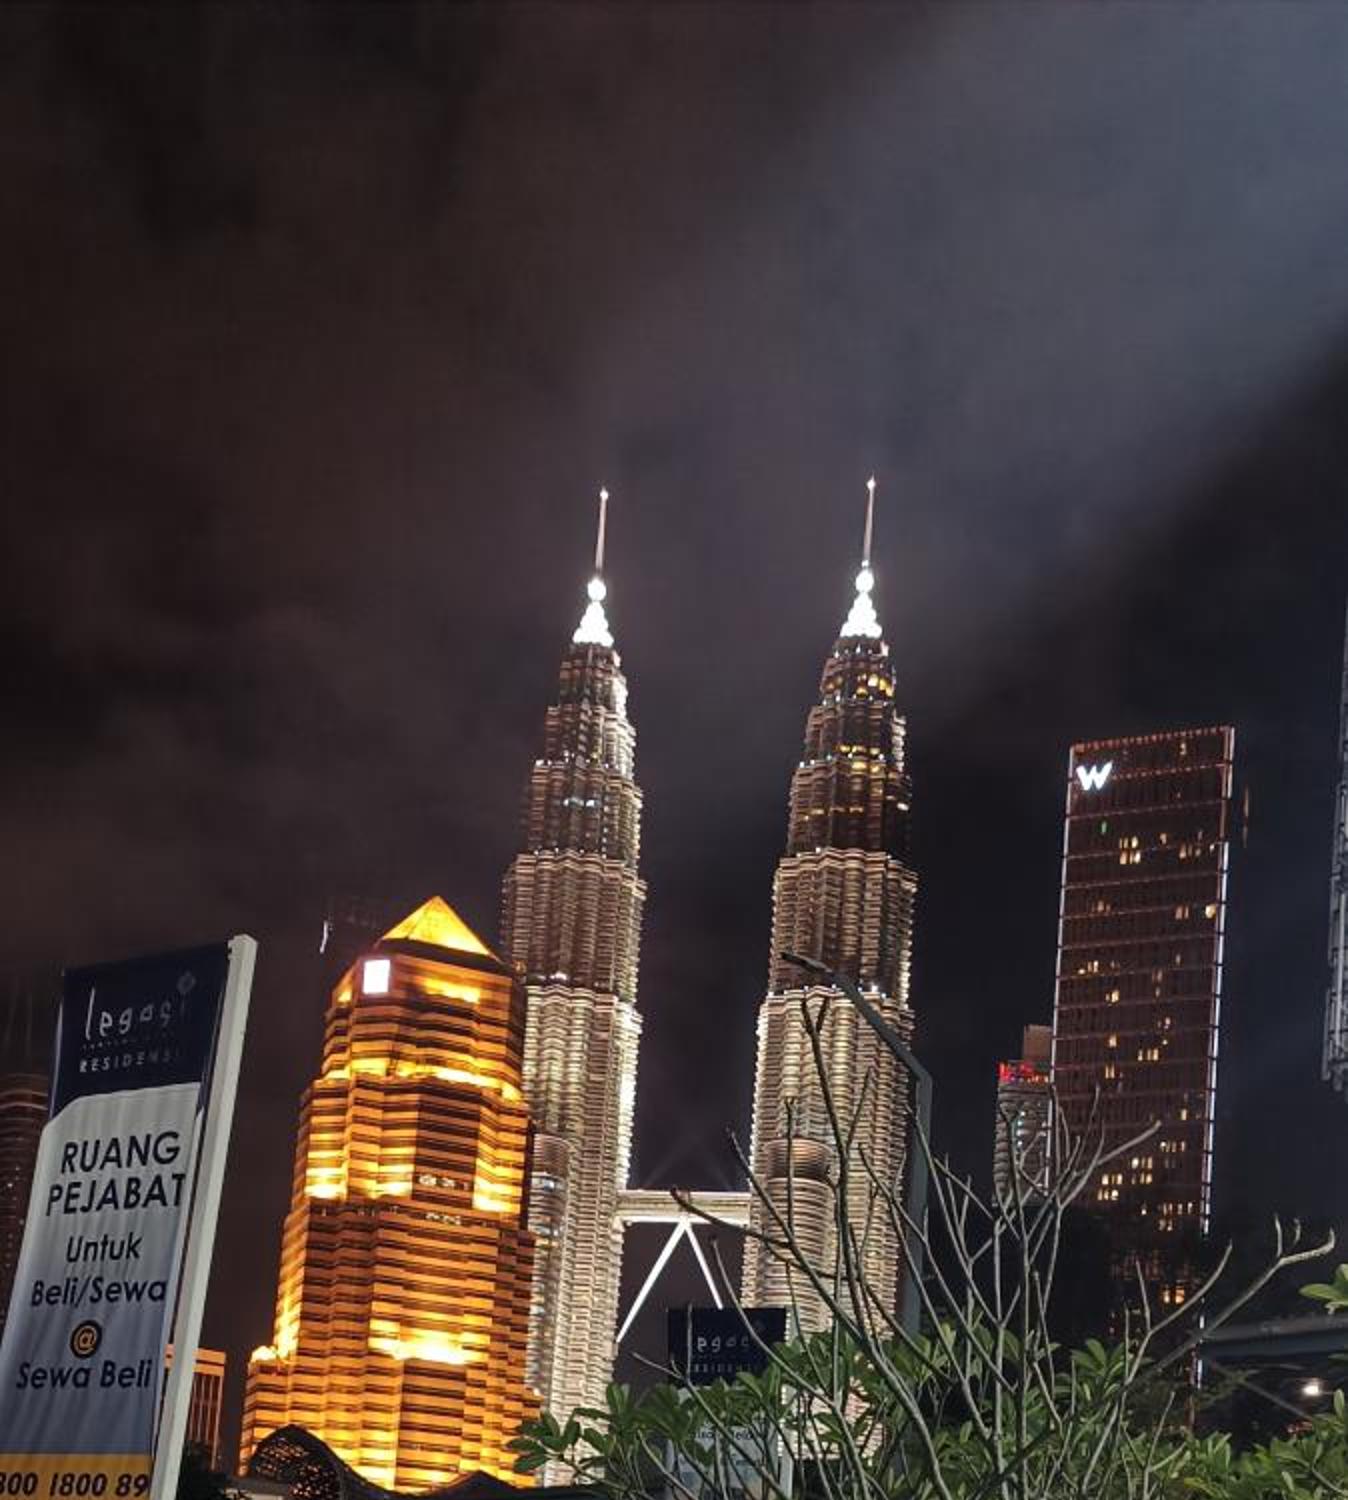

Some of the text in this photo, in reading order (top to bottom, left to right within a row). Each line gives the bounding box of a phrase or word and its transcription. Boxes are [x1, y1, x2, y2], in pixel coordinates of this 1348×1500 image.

[1075, 760, 1112, 791] W
[61, 1131, 180, 1174] RUANG
[46, 1173, 186, 1217] PEJABAT
[66, 1232, 142, 1263] Untuk
[31, 1276, 168, 1308] Beli/Sewa
[73, 1323, 98, 1356] @
[16, 1359, 152, 1390] Sewa Beli
[50, 1472, 108, 1497] 1800
[115, 1473, 150, 1498] 89
